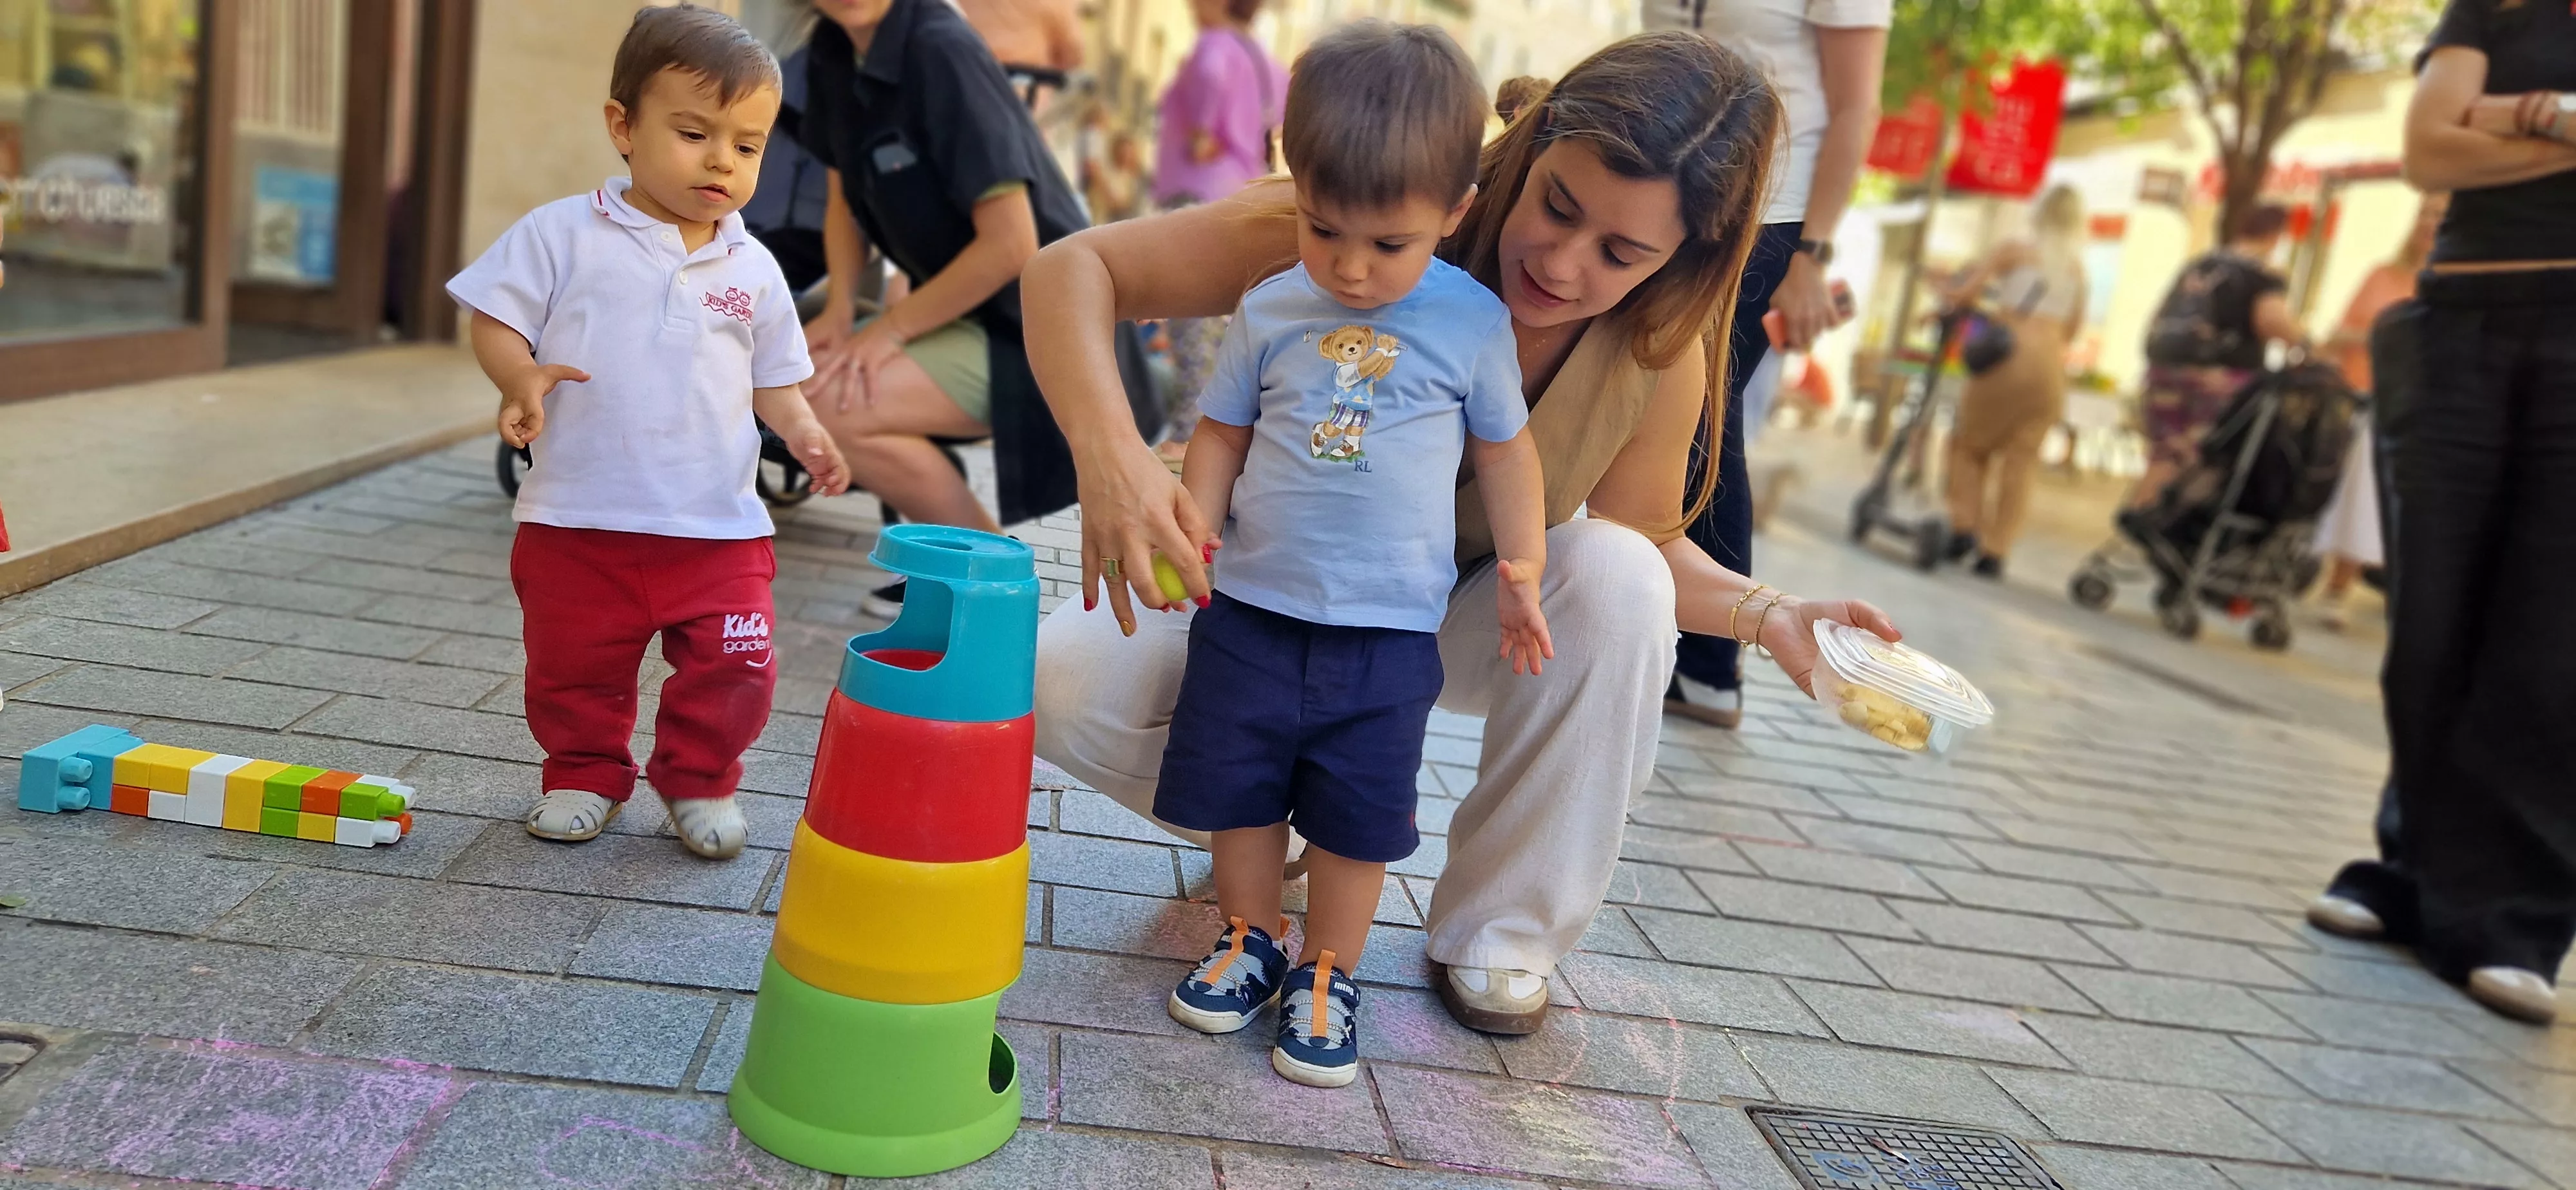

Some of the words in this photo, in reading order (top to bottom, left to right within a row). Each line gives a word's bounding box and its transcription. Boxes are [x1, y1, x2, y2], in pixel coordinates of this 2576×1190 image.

[1354, 460, 1372, 473] RL
[723, 612, 768, 638] Kid's
[723, 637, 770, 654] garden
